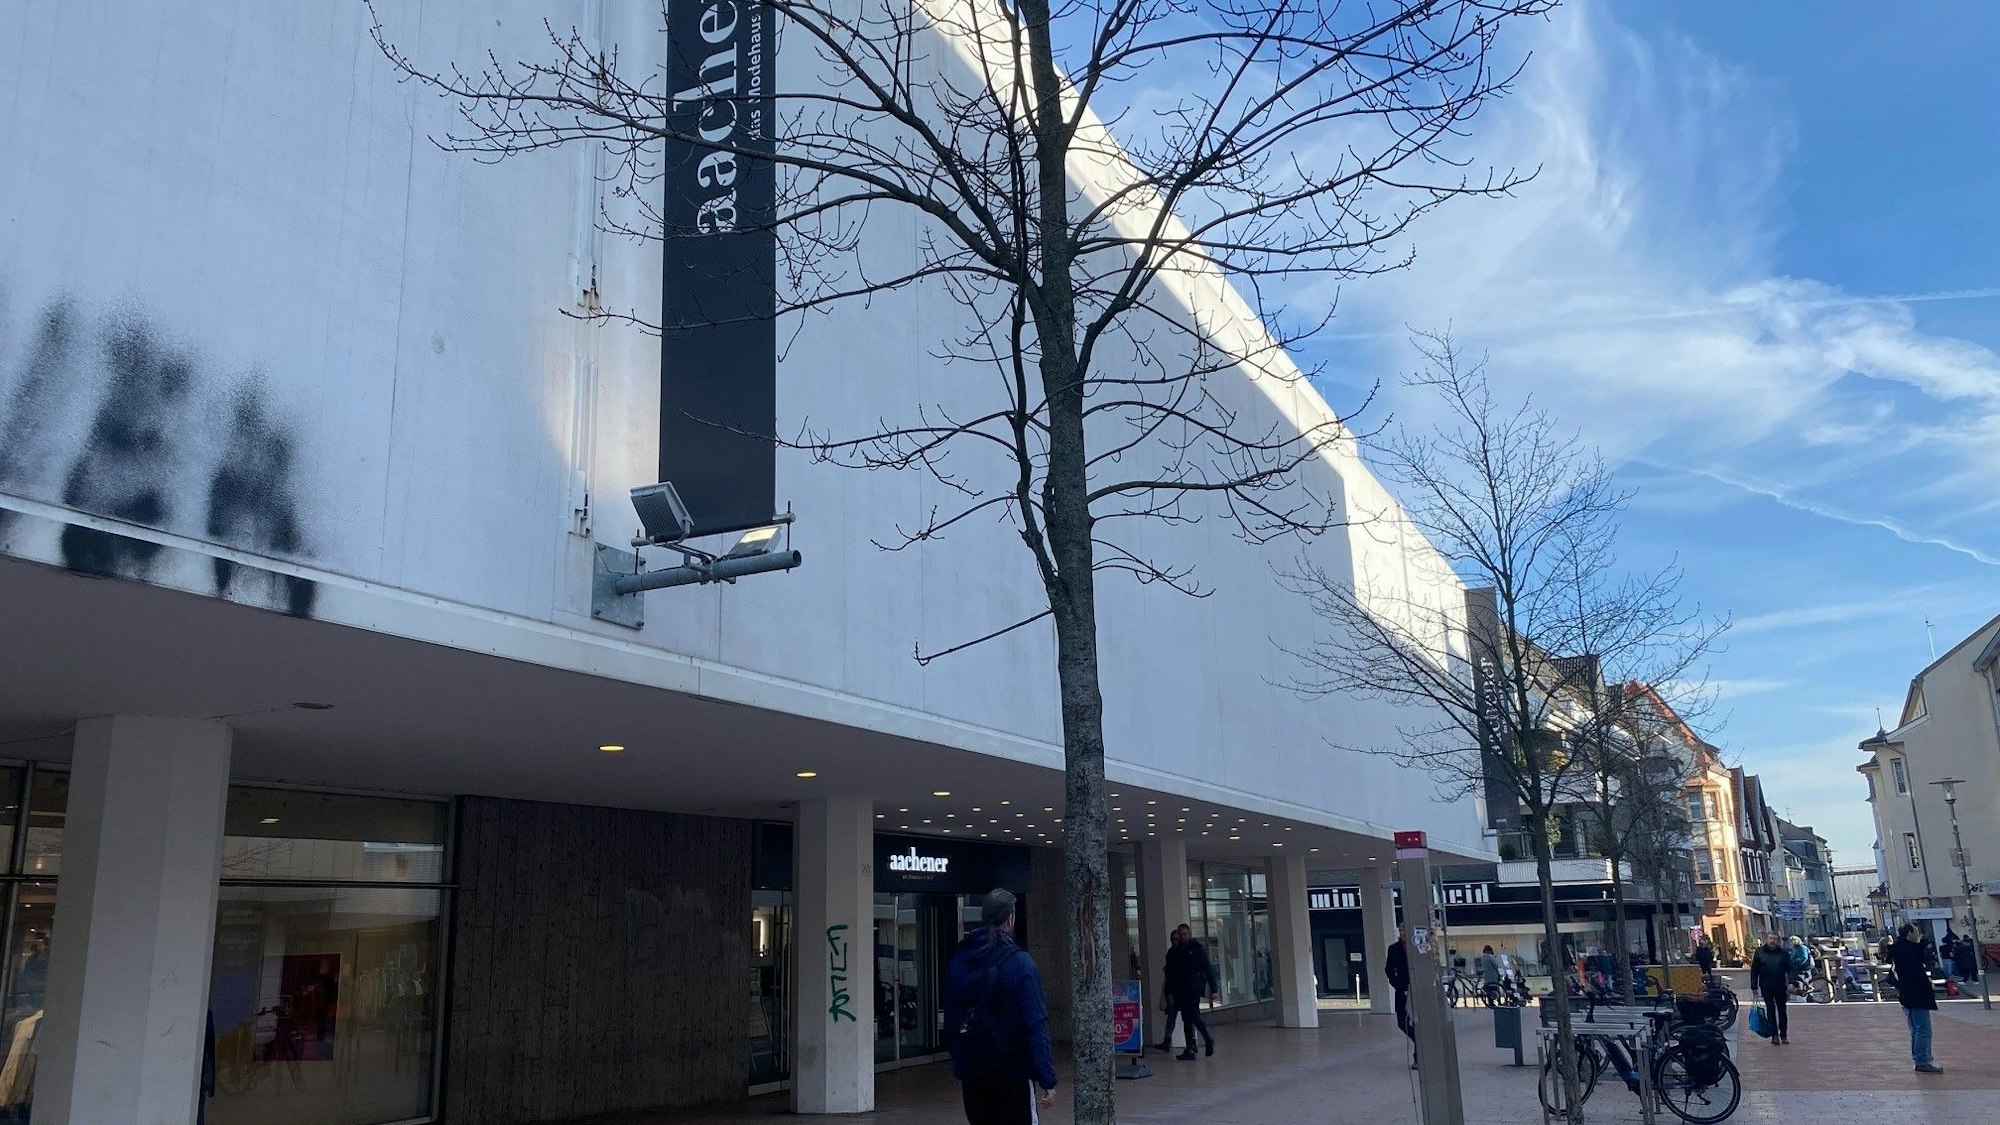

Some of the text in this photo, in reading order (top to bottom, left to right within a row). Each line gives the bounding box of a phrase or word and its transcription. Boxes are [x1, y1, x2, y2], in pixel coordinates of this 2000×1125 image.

[748, 14, 761, 103] Modehaus
[673, 0, 738, 234] aache
[748, 110, 761, 140] das
[889, 846, 949, 873] aachener
